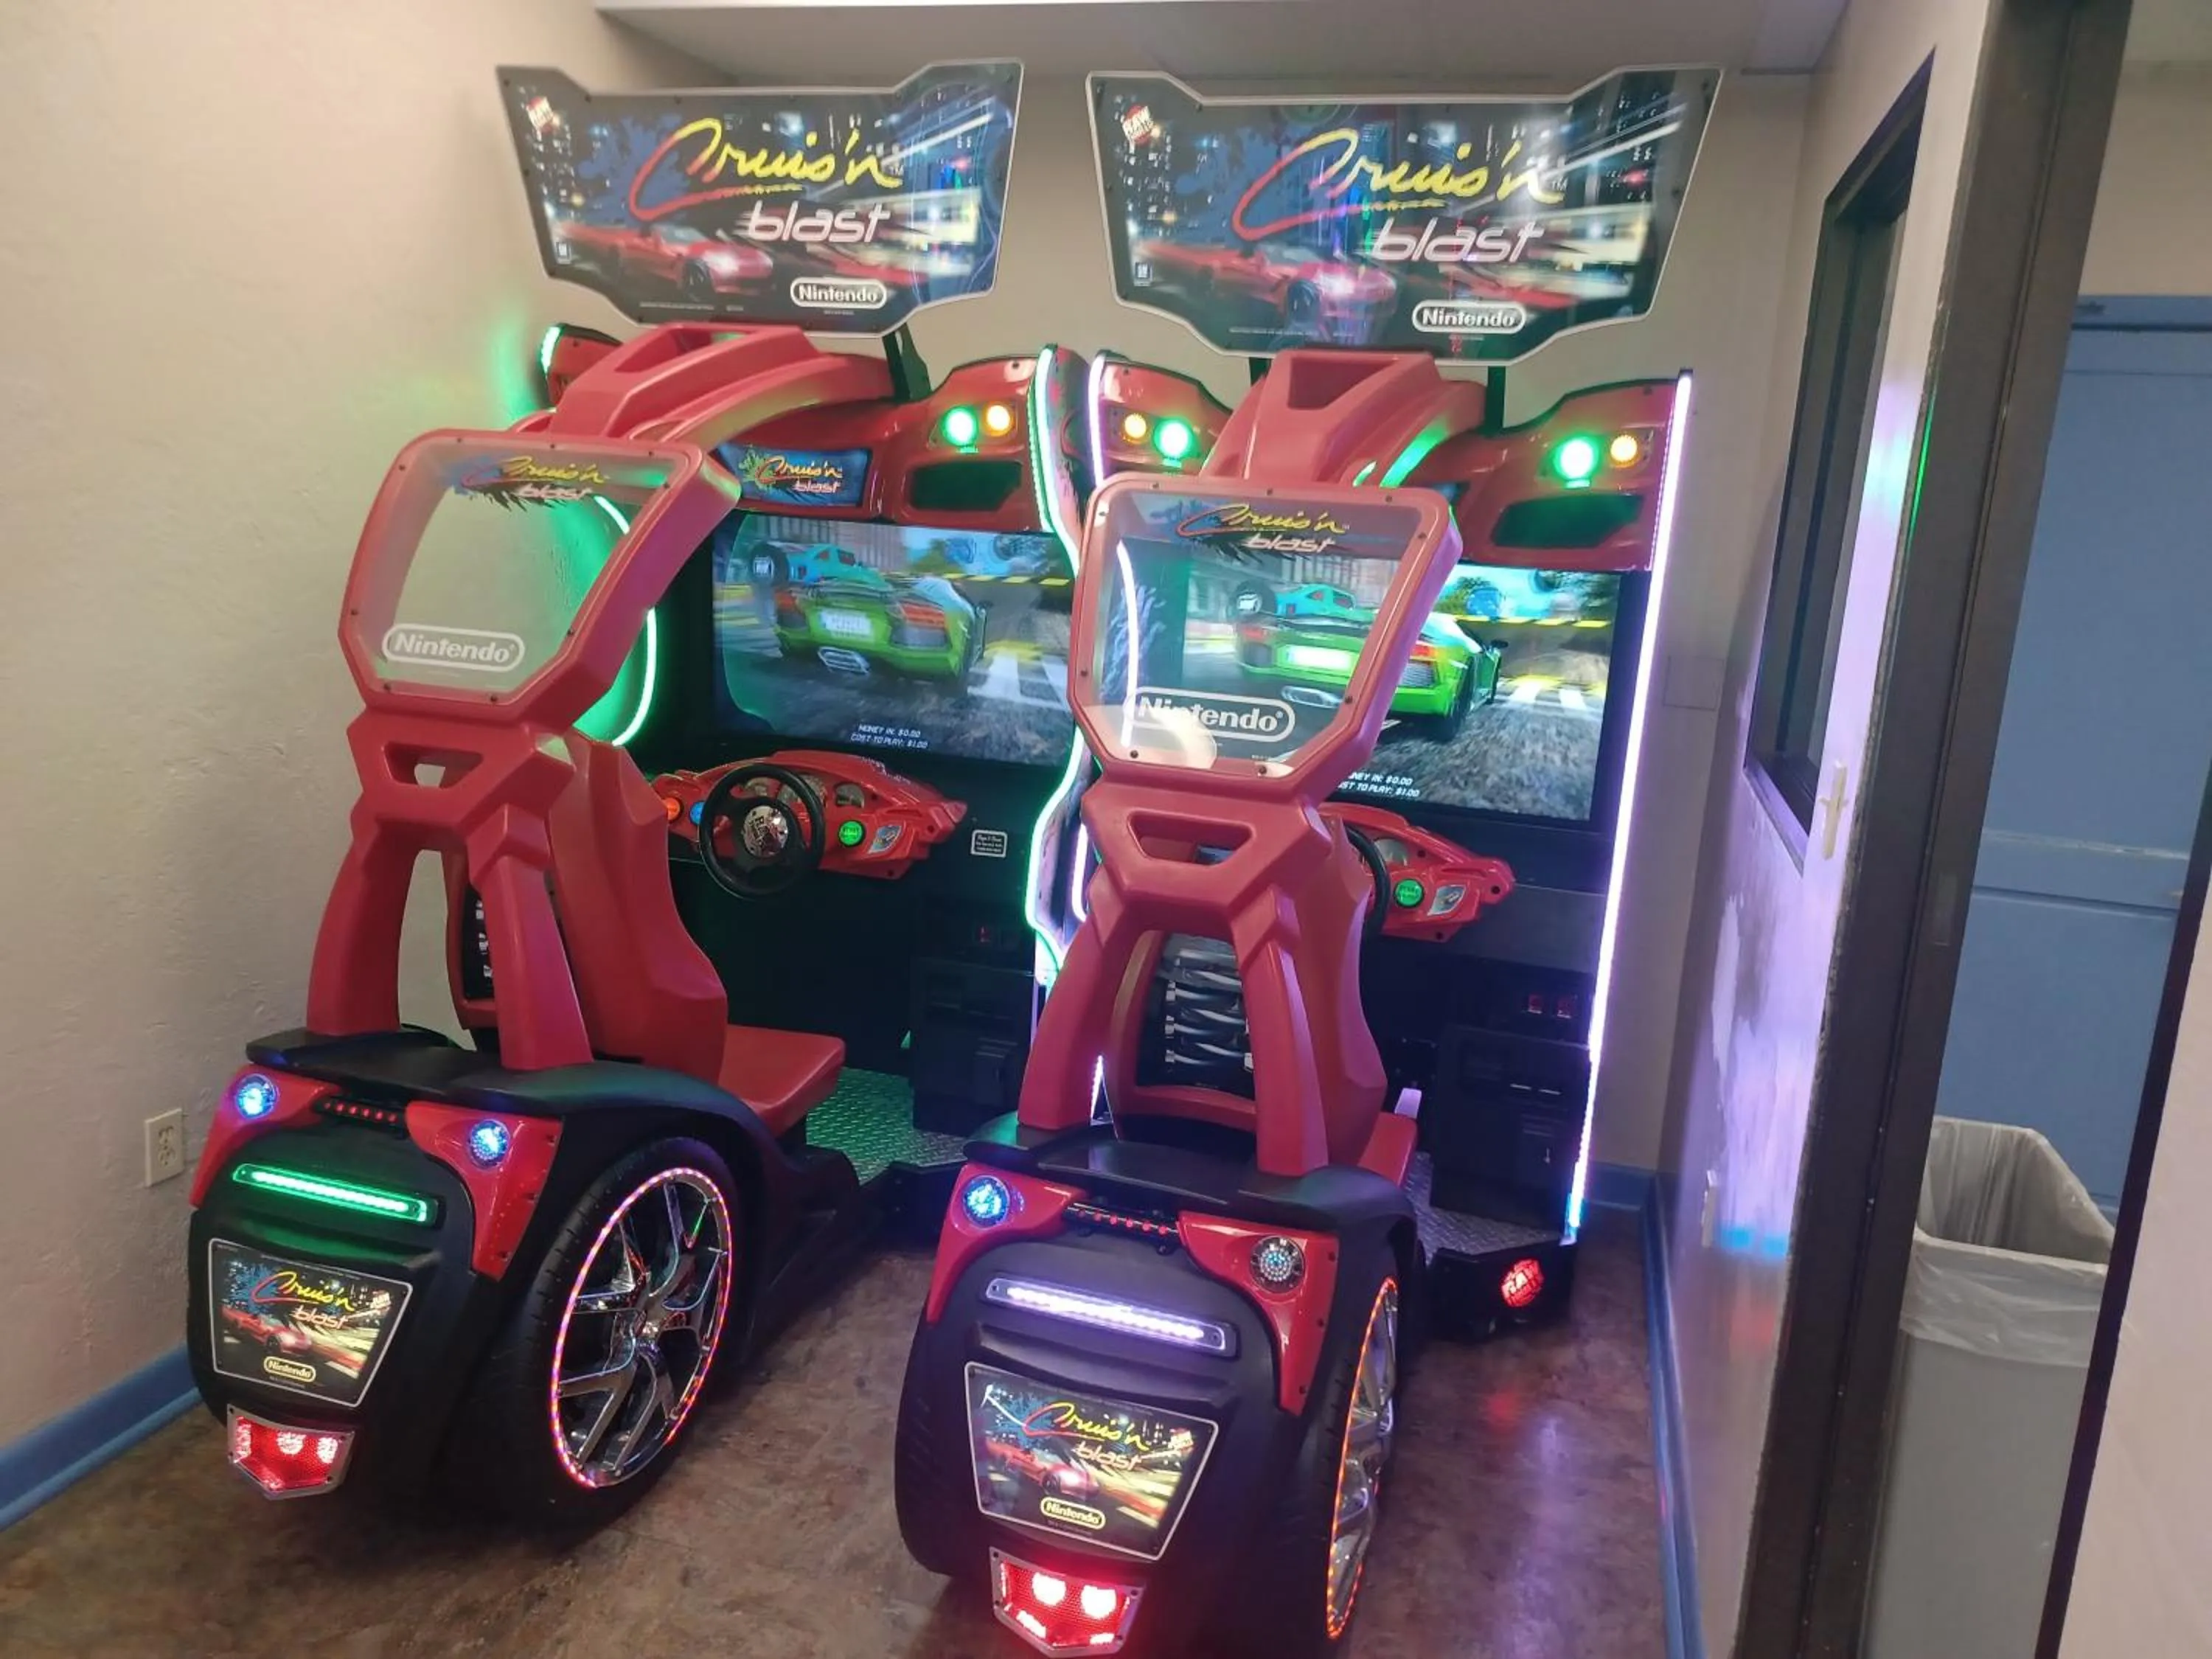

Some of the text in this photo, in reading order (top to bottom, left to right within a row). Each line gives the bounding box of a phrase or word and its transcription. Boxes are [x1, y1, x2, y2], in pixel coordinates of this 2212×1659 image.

[629, 117, 902, 220] Cruis'n
[1233, 128, 1565, 241] Cruis'n
[746, 199, 891, 243] blast
[1371, 216, 1545, 263] blast
[798, 283, 878, 303] Nintendo
[1422, 307, 1515, 327] Nintendo
[516, 482, 593, 500] blast
[793, 479, 841, 493] blast
[1177, 503, 1346, 538] Cruis'n
[1245, 532, 1336, 553] blast
[394, 632, 510, 664] Nintendo
[874, 736, 883, 745] TO
[1357, 782, 1368, 791] TO
[1368, 784, 1392, 794] PLAY:
[1395, 787, 1420, 797] $1.00
[1385, 775, 1413, 786] $0.00
[251, 1270, 355, 1312] Cruis'n
[293, 1304, 349, 1329] blast
[268, 1360, 312, 1378] Nintendo
[1023, 1402, 1150, 1451] Cruis'n
[1074, 1441, 1143, 1470] blast
[1046, 1501, 1100, 1525] Nintendo
